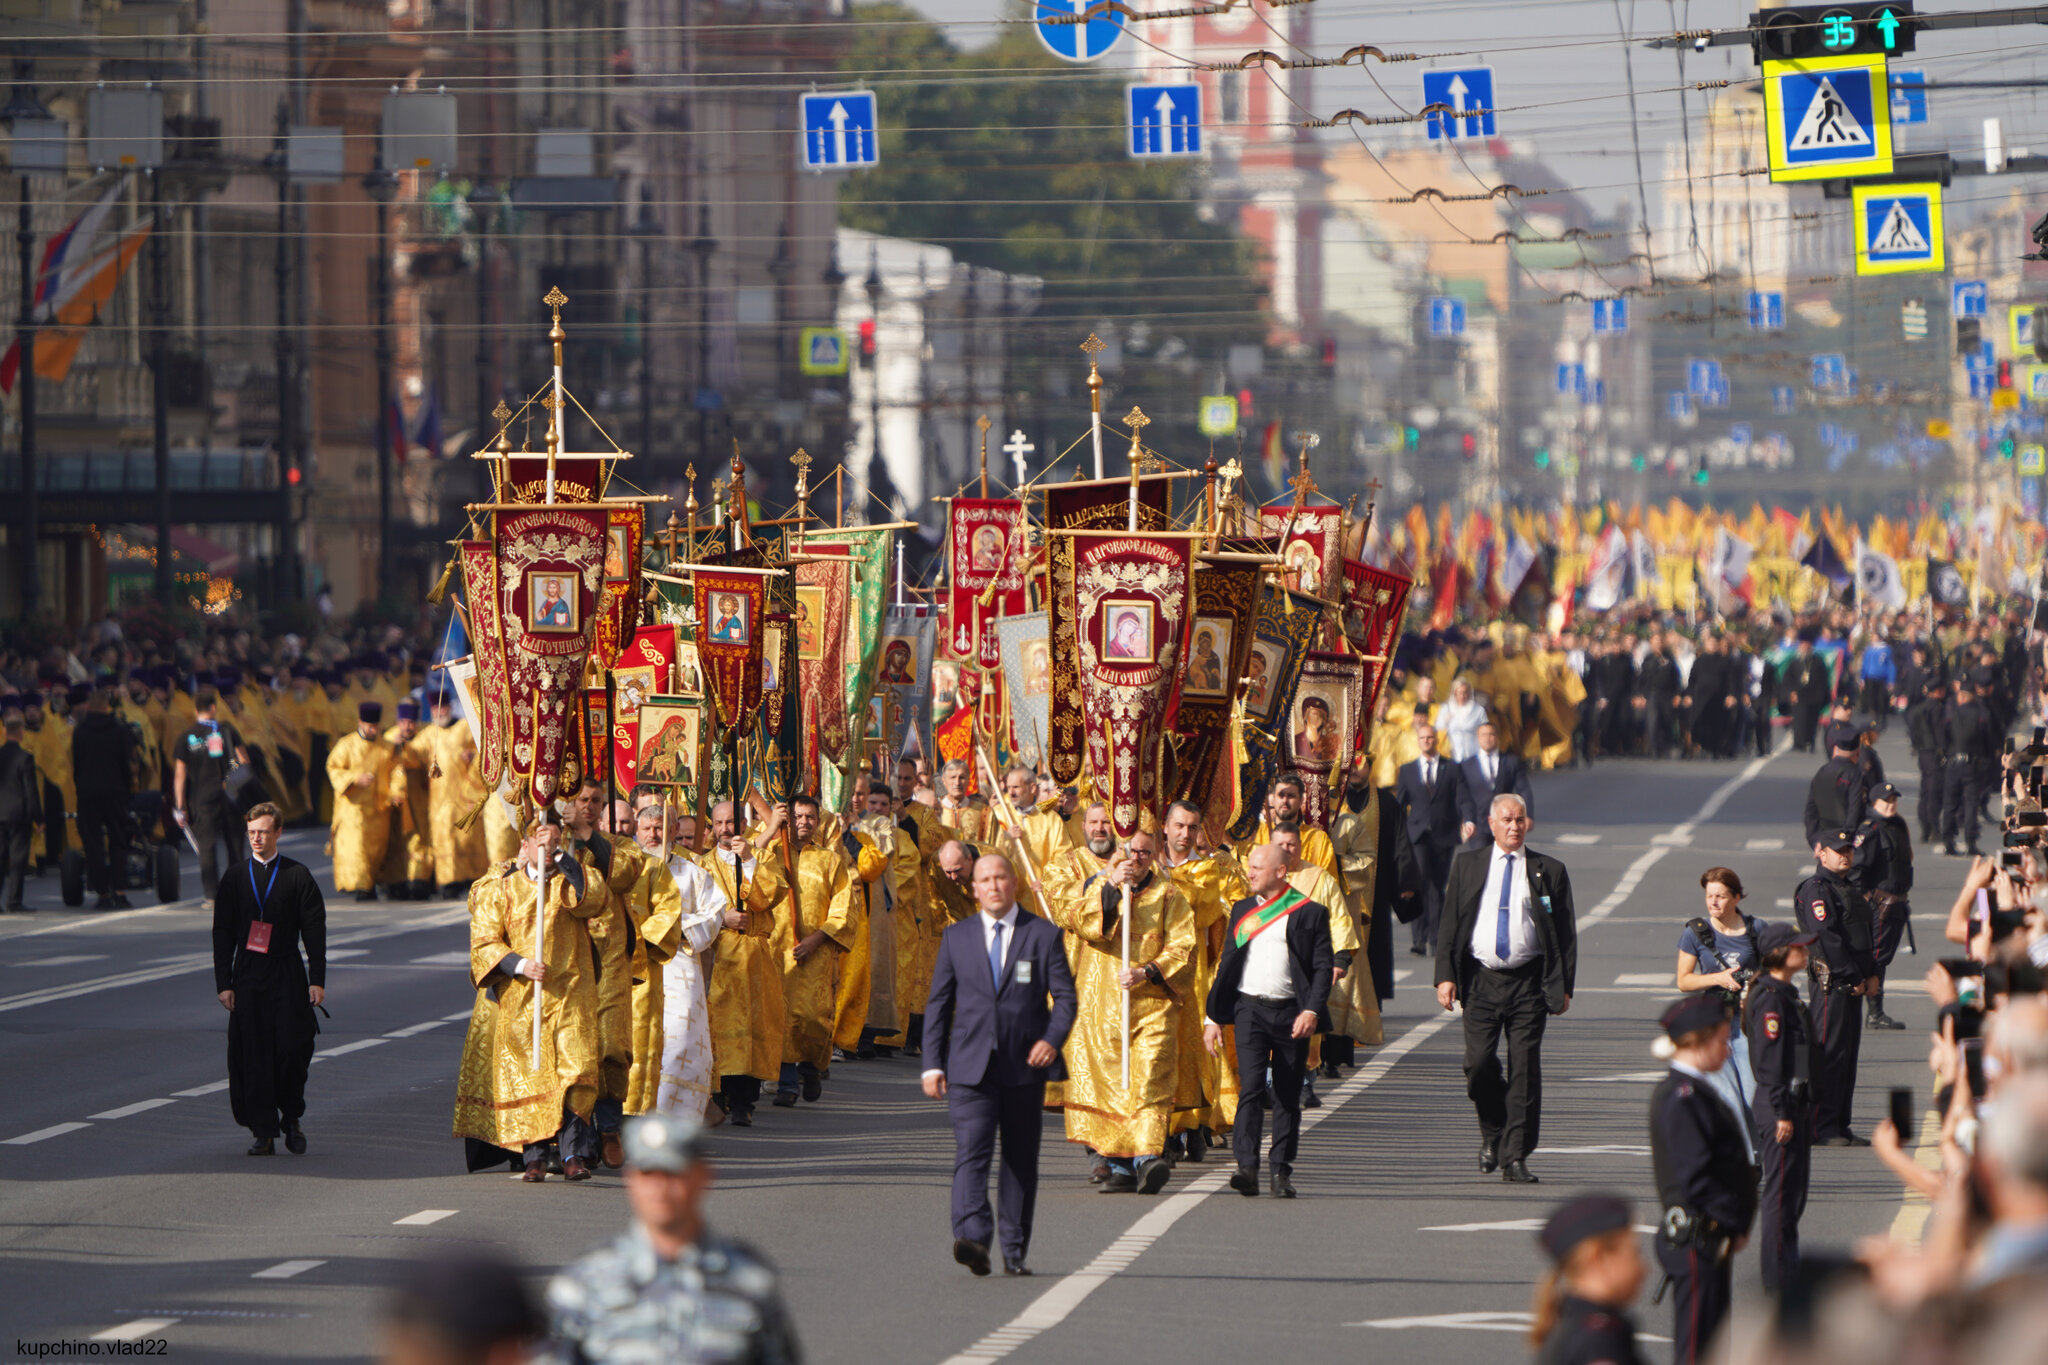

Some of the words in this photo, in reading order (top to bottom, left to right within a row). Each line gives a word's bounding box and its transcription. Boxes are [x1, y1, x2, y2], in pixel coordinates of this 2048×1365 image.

[1823, 15, 1856, 47] 35
[516, 479, 591, 501] ЦАРСКЕЛЬСКОЕ
[506, 511, 599, 539] ЦАРСКОСЕЛЬСКОЕ
[1063, 503, 1157, 528] ЦАРСКОСЕЛЬКОЕ
[1085, 539, 1180, 566] ЦАРСКОСЕЛЬСКОЕ
[521, 634, 586, 655] БЛАГОЧИНИЕ
[1096, 664, 1163, 685] БЛАГОЧИНИЕ
